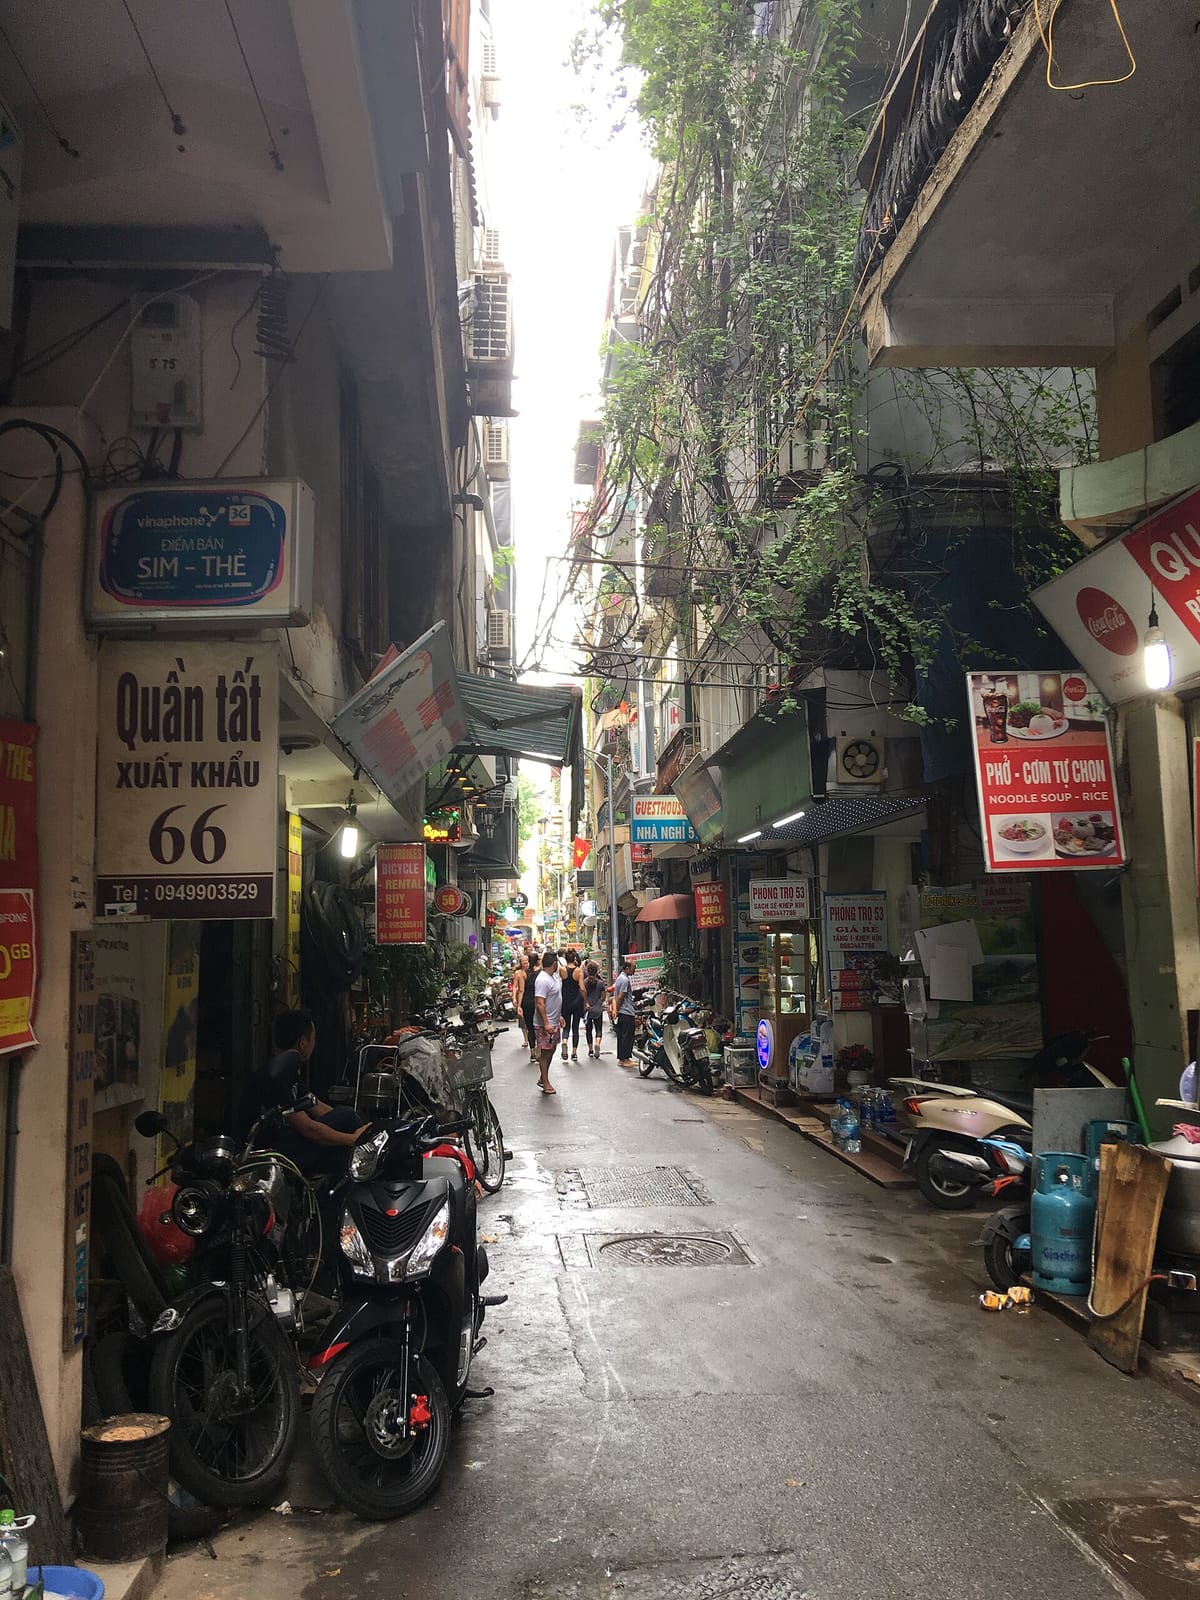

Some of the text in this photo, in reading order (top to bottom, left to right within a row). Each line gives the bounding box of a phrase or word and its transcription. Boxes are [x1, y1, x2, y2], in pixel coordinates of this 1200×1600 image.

[137, 506, 248, 529] vinaphone 3G
[137, 557, 178, 579] SIM
[117, 658, 204, 751] Quần
[216, 657, 262, 742] tất
[116, 750, 260, 789] XUẤT KHẨU
[985, 754, 1012, 786] PHỞ
[1022, 759, 1052, 785] CƠM
[1071, 760, 1107, 788] CHỌN
[989, 793, 1038, 804] NOODLE
[1040, 793, 1072, 803] SOUP
[1082, 791, 1109, 801] RICE
[149, 803, 228, 865] 66
[637, 823, 658, 840] NHÀ
[382, 863, 419, 875] BICYCLE
[113, 885, 137, 901] Tel
[154, 883, 258, 901] 0949903529
[385, 879, 423, 890] RENTAL
[795, 886, 805, 899] 53
[385, 893, 405, 904] BUY
[385, 908, 411, 919] SALE
[874, 906, 884, 921] 53
